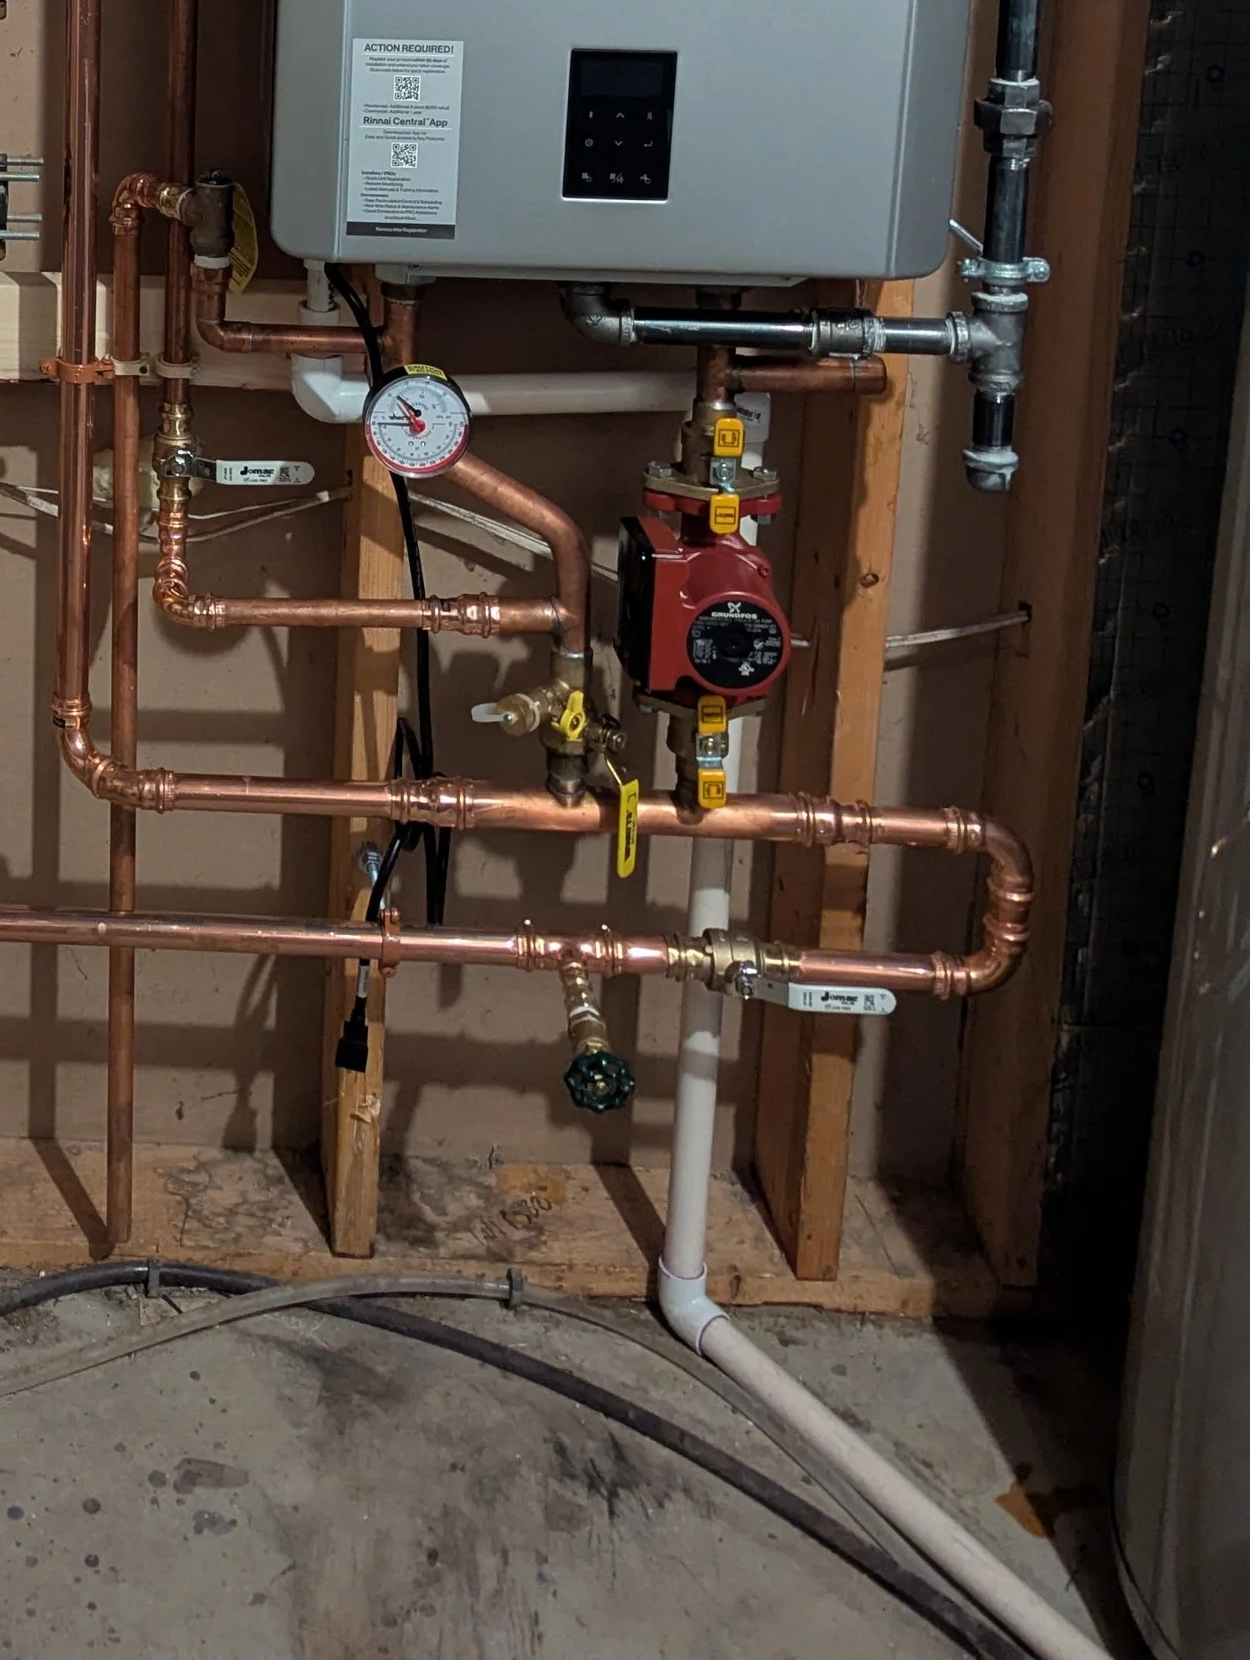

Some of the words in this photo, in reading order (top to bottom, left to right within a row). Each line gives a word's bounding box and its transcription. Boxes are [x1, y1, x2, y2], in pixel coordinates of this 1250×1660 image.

[364, 43, 401, 53] ACTION
[401, 43, 454, 54] REQUIRED!
[363, 116, 391, 125] Rinnai
[429, 118, 448, 128] App
[240, 466, 275, 476] Jomar
[711, 611, 758, 620] GRUNDFOS
[821, 991, 858, 1002] Jomar
